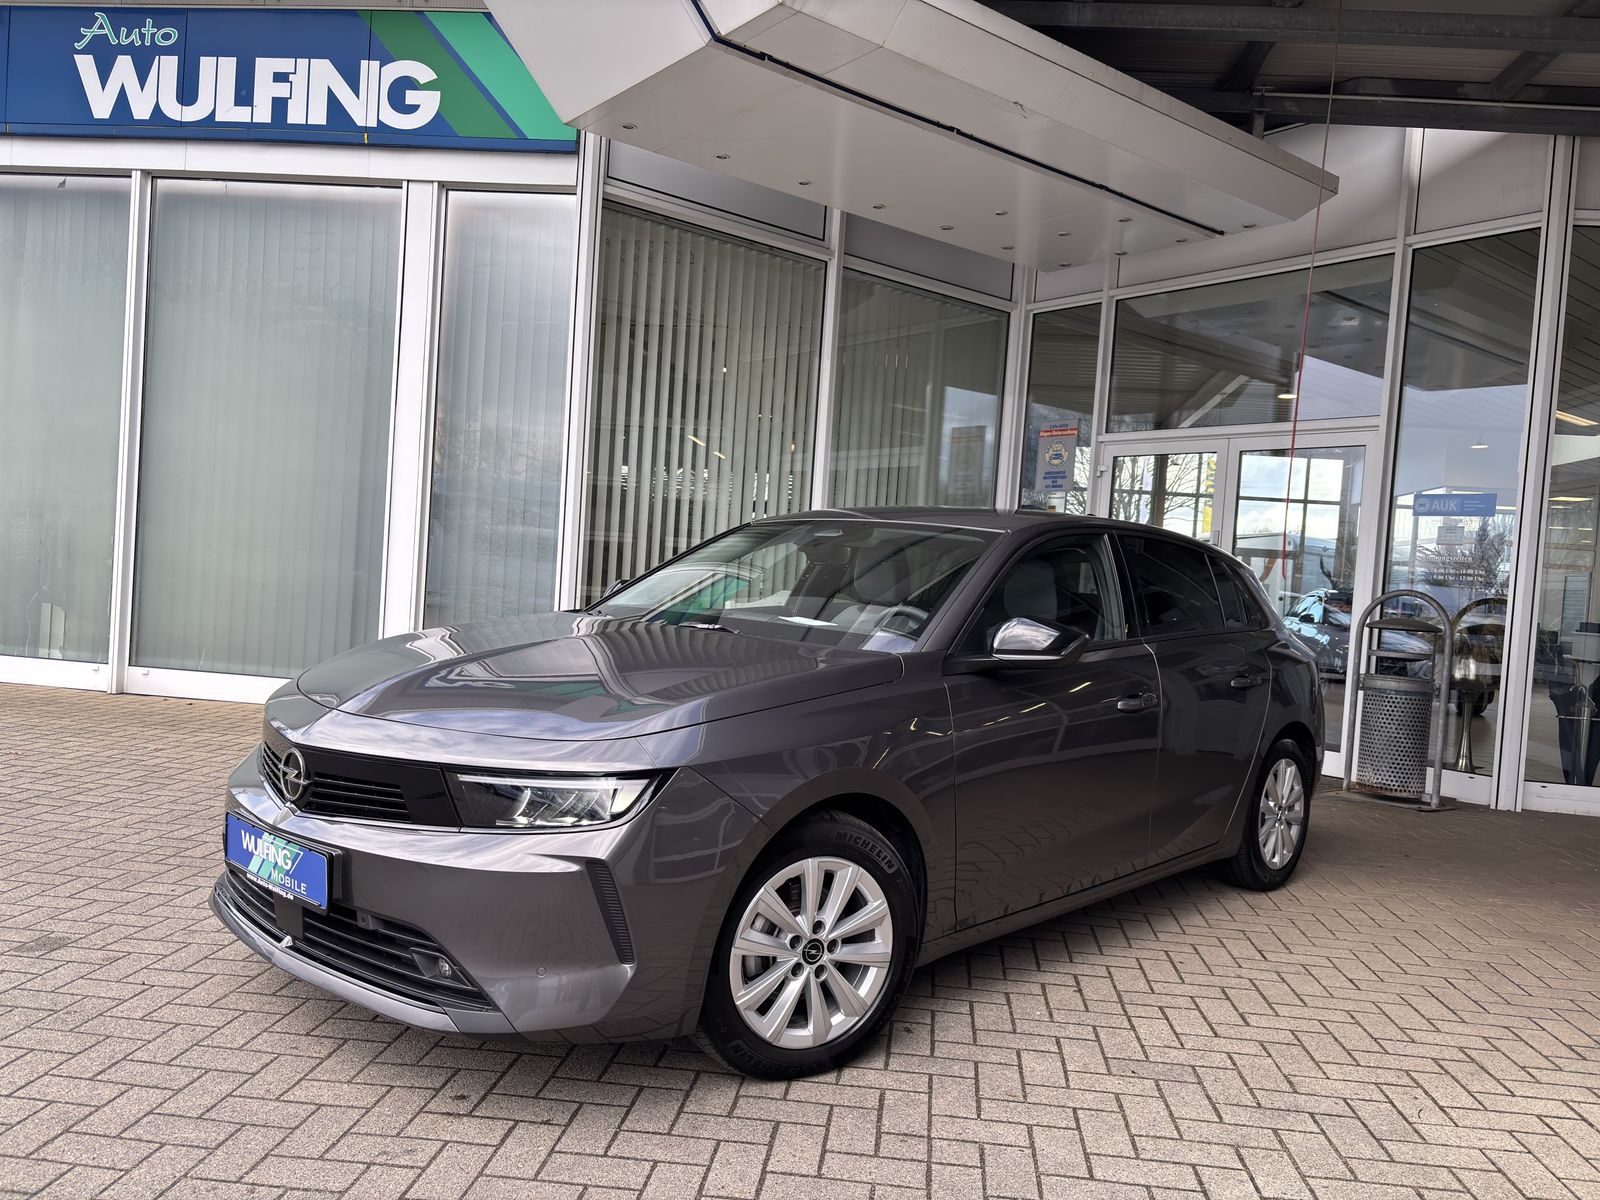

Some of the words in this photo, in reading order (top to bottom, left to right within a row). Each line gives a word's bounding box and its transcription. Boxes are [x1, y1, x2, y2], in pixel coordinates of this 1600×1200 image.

[74, 11, 179, 49] Auto
[73, 54, 441, 130] WULFING
[1431, 499, 1457, 511] AUK
[241, 829, 292, 871] WULFING
[835, 831, 895, 870] MICHELIN
[271, 869, 308, 895] MOBILE
